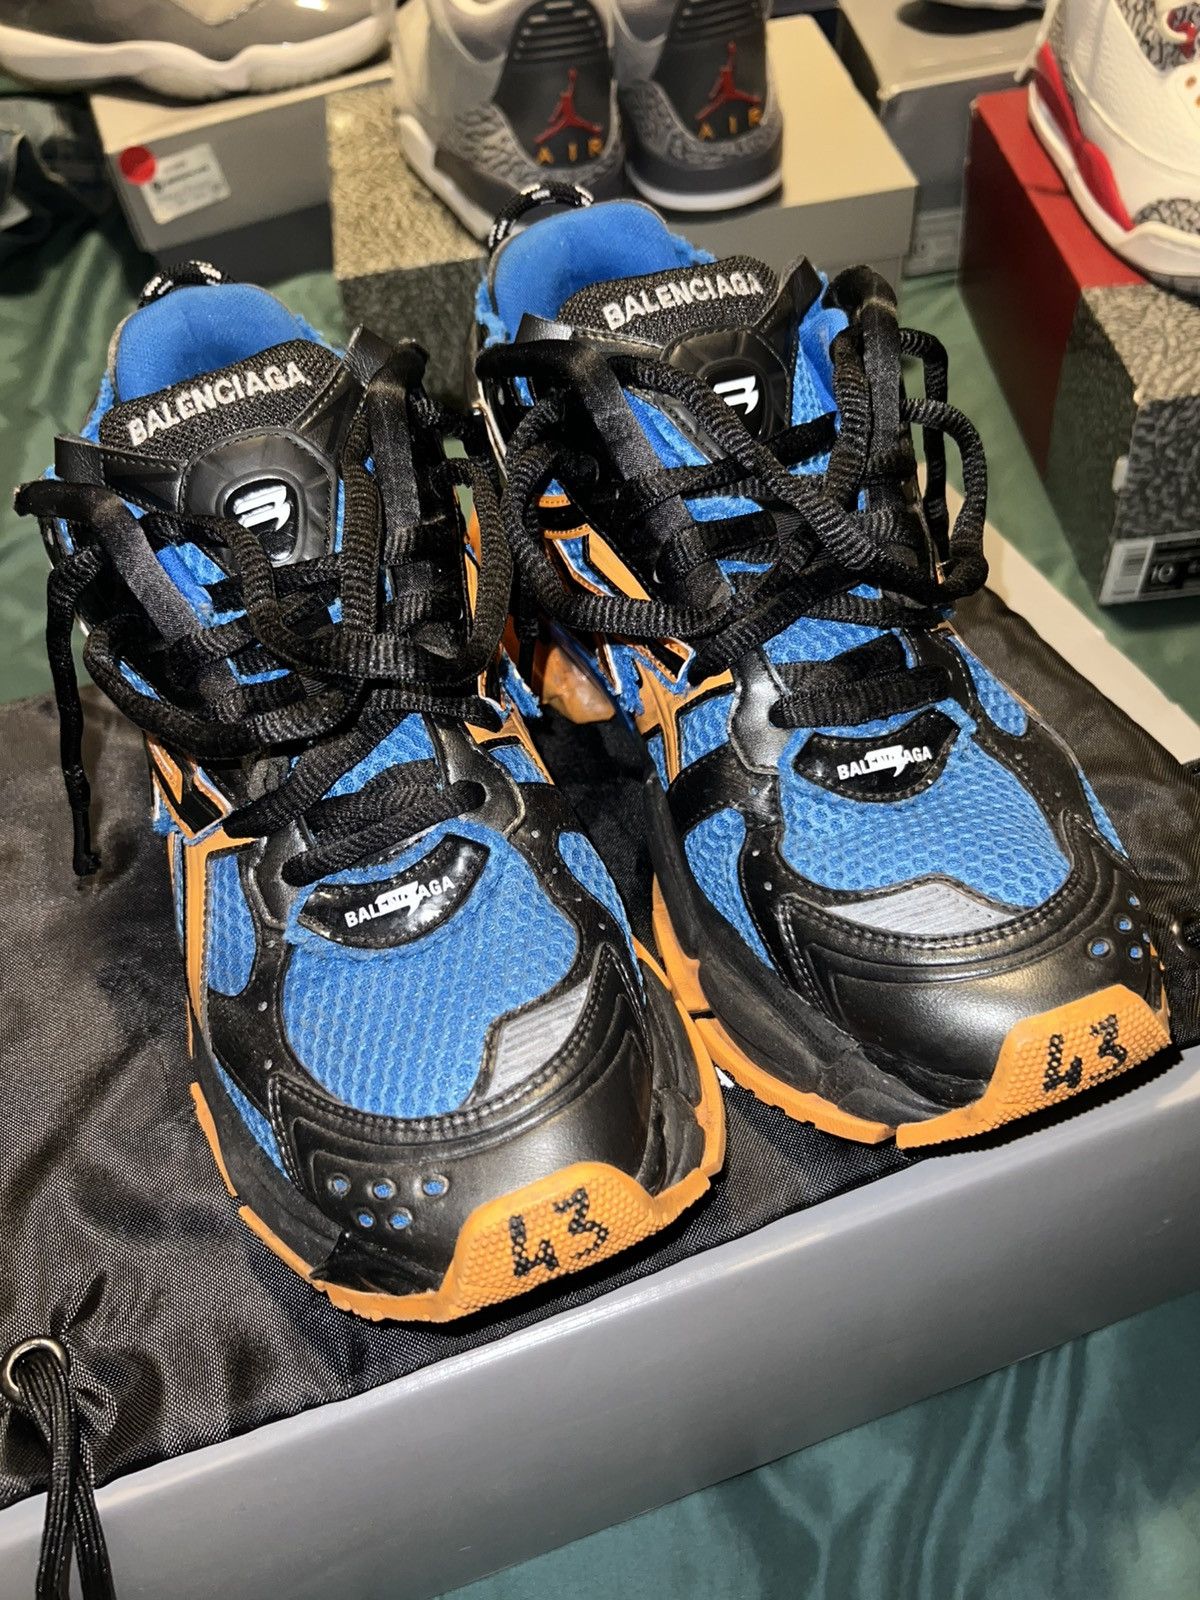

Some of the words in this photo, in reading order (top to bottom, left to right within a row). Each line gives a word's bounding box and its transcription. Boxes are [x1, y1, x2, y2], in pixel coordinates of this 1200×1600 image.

[602, 271, 764, 330] BALENCIAGA
[127, 361, 312, 446] BALENCIAGA
[836, 745, 933, 780] BALAGA
[344, 875, 456, 928] BALAGA
[1043, 1013, 1128, 1092] 43
[508, 1186, 610, 1278] 43
